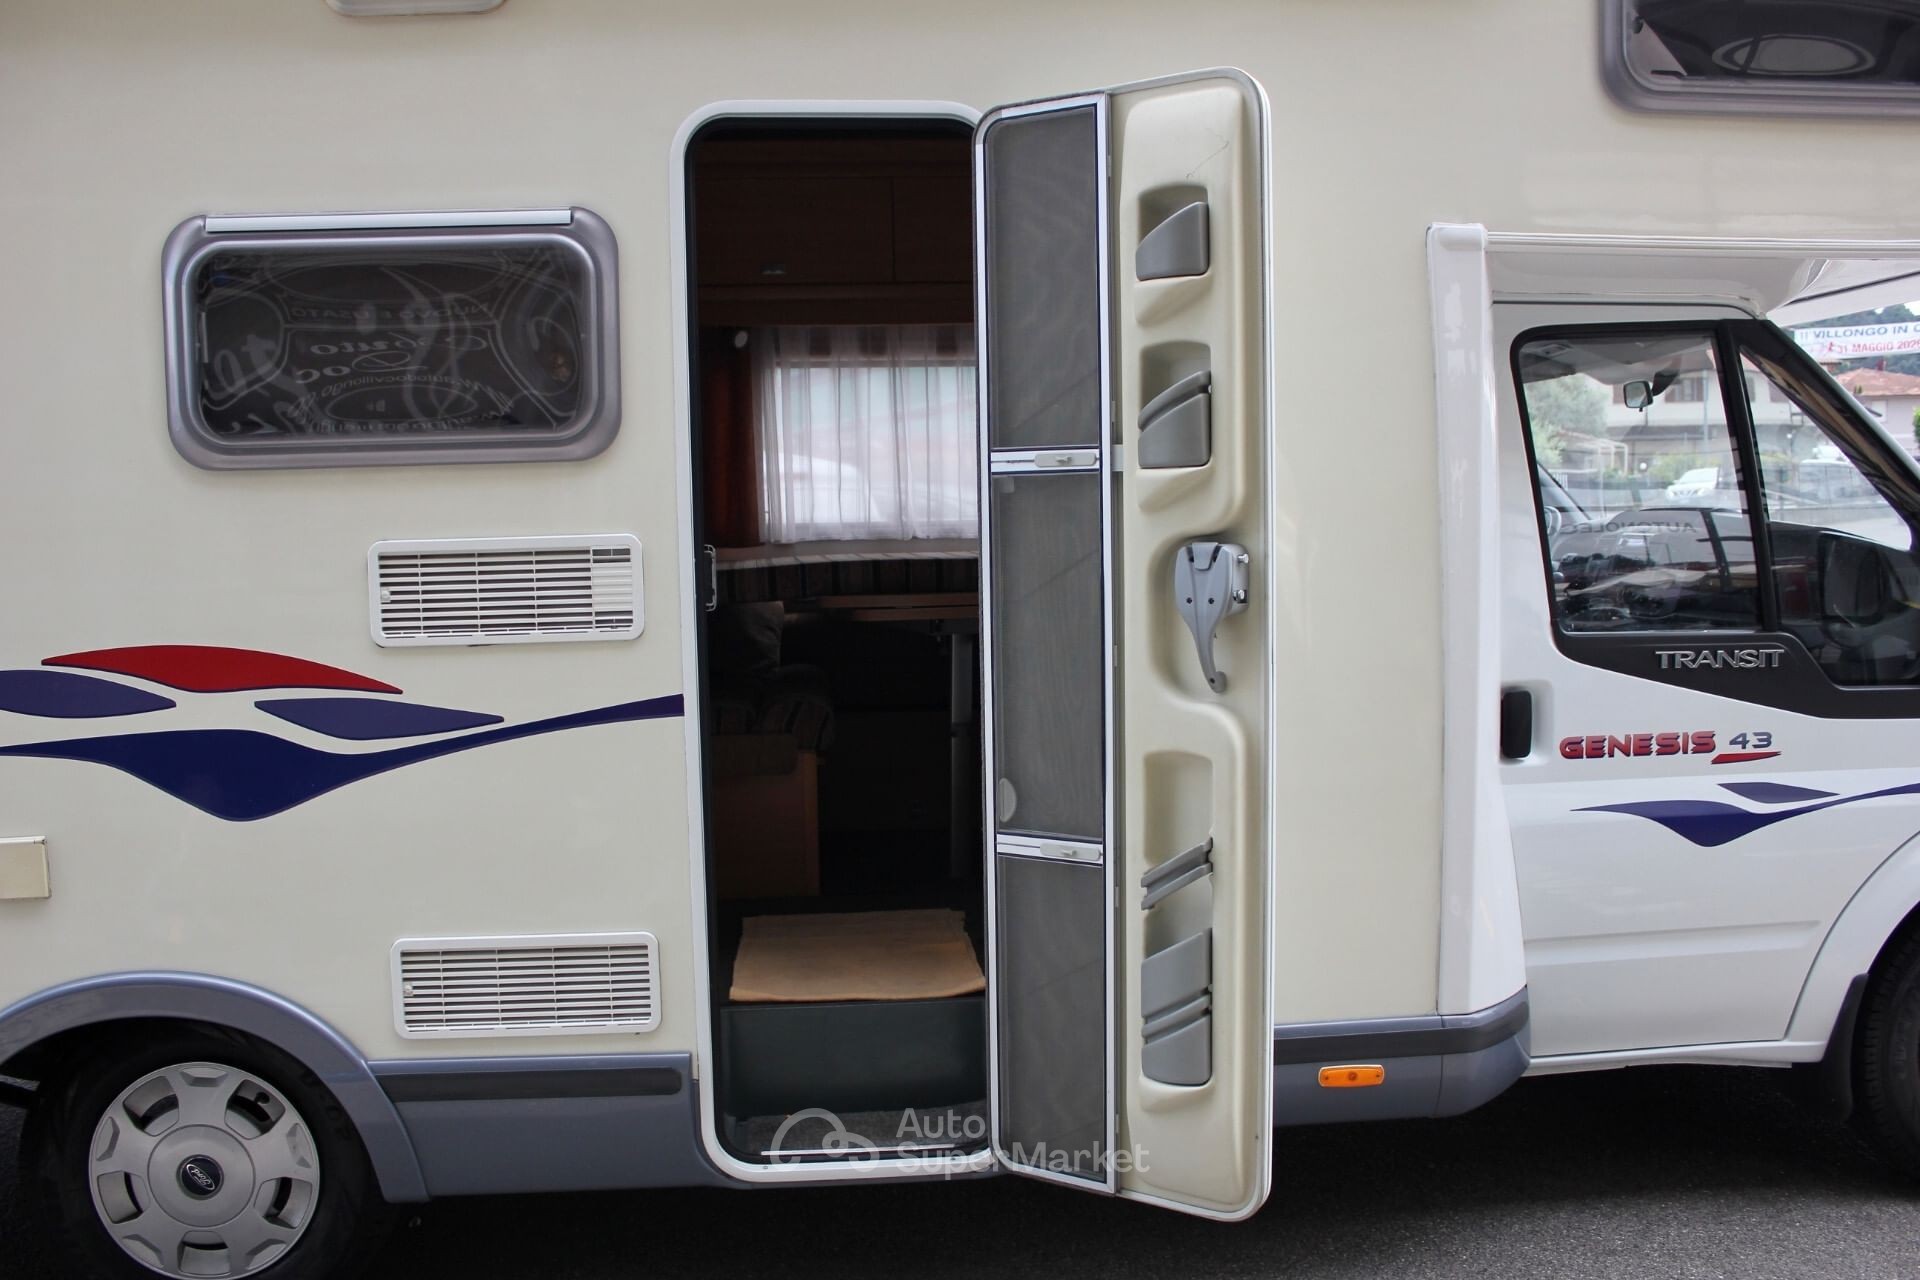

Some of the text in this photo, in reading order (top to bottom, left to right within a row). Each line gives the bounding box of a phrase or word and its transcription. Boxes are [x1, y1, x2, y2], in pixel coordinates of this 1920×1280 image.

[1813, 326, 1888, 339] VILLONGO
[1892, 324, 1908, 335] IN
[1851, 342, 1894, 353] MAGGIO
[1655, 648, 1785, 669] TRANSIT
[1559, 729, 1773, 760] GENESIS 43
